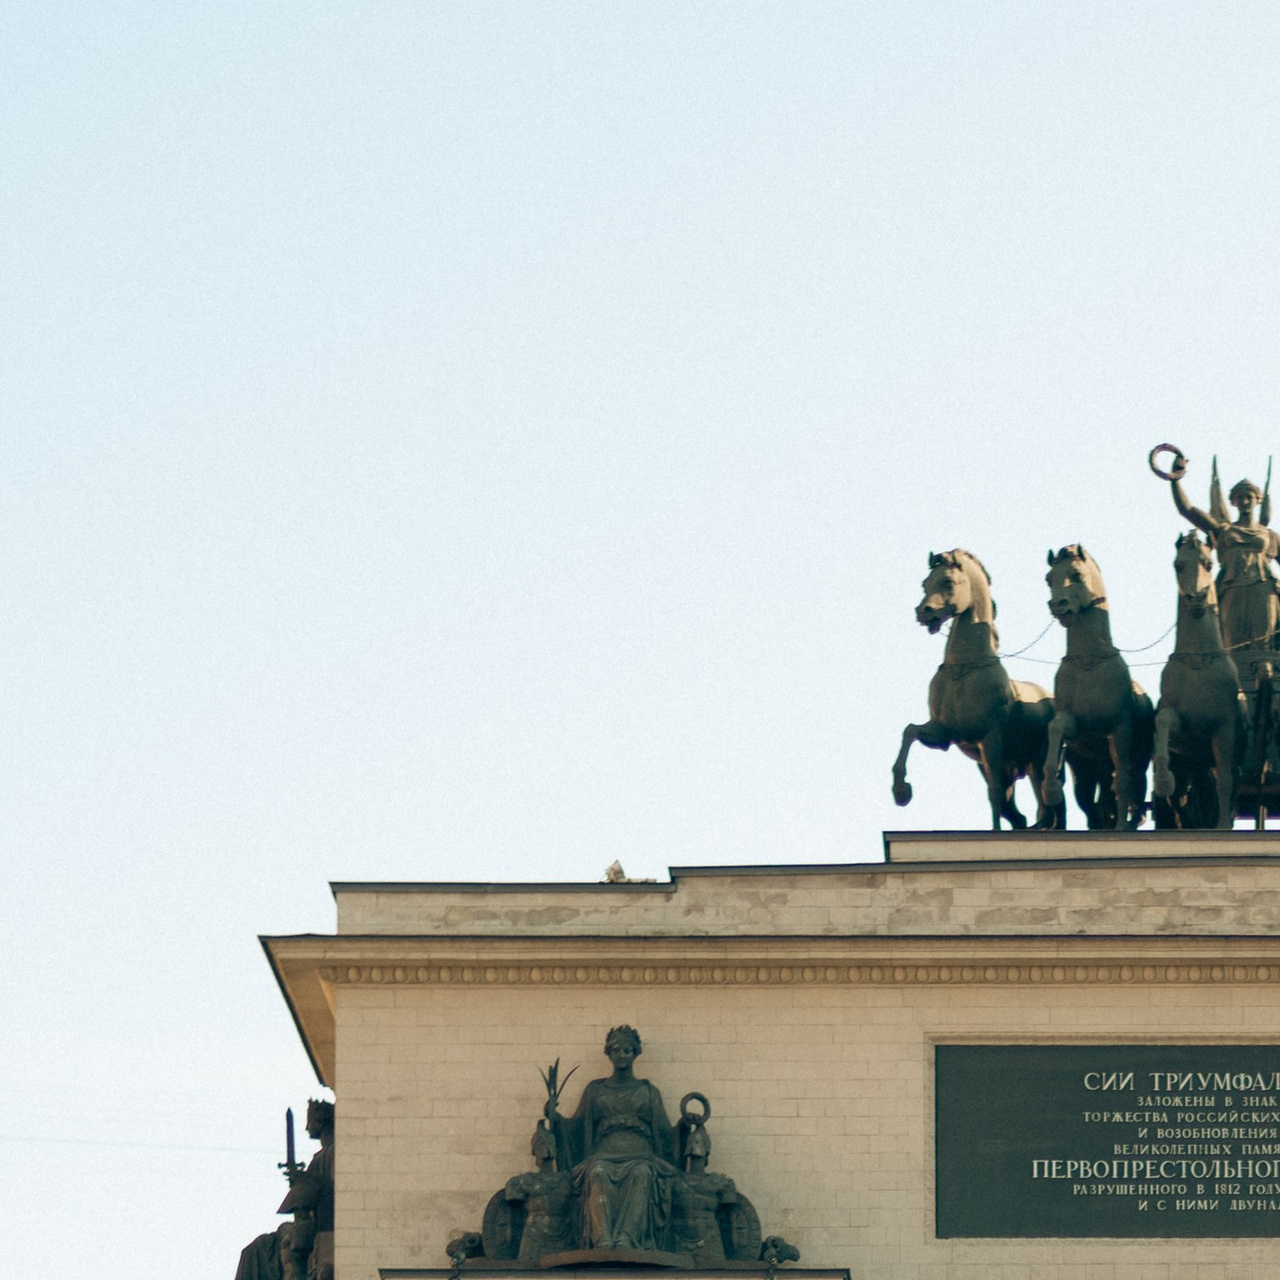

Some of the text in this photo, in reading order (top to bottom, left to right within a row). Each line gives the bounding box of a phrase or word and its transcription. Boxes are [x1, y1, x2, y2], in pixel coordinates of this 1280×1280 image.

[1083, 1071, 1135, 1091] СИИ
[1137, 1095, 1216, 1107] ЗАЛОЖЕНЫ
[1224, 1096, 1233, 1107] В
[1242, 1095, 1278, 1107] ЗНАК
[1082, 1111, 1169, 1123] ТОРЖЕСТВА
[1177, 1110, 1280, 1123] РОССИЙСКИХ
[1137, 1127, 1149, 1139] И
[1156, 1127, 1278, 1139] ВОЗОБНОВЛЕНИЯ
[1113, 1143, 1232, 1155] ВЕЛИКОЛЕПНЫХ
[1073, 1183, 1188, 1196] РАЗРУШЕННОГО
[1196, 1183, 1205, 1196] В
[1214, 1183, 1241, 1195] 1812
[1138, 1199, 1149, 1211] И
[1156, 1199, 1167, 1211] С
[1175, 1199, 1219, 1211] НИМИ
